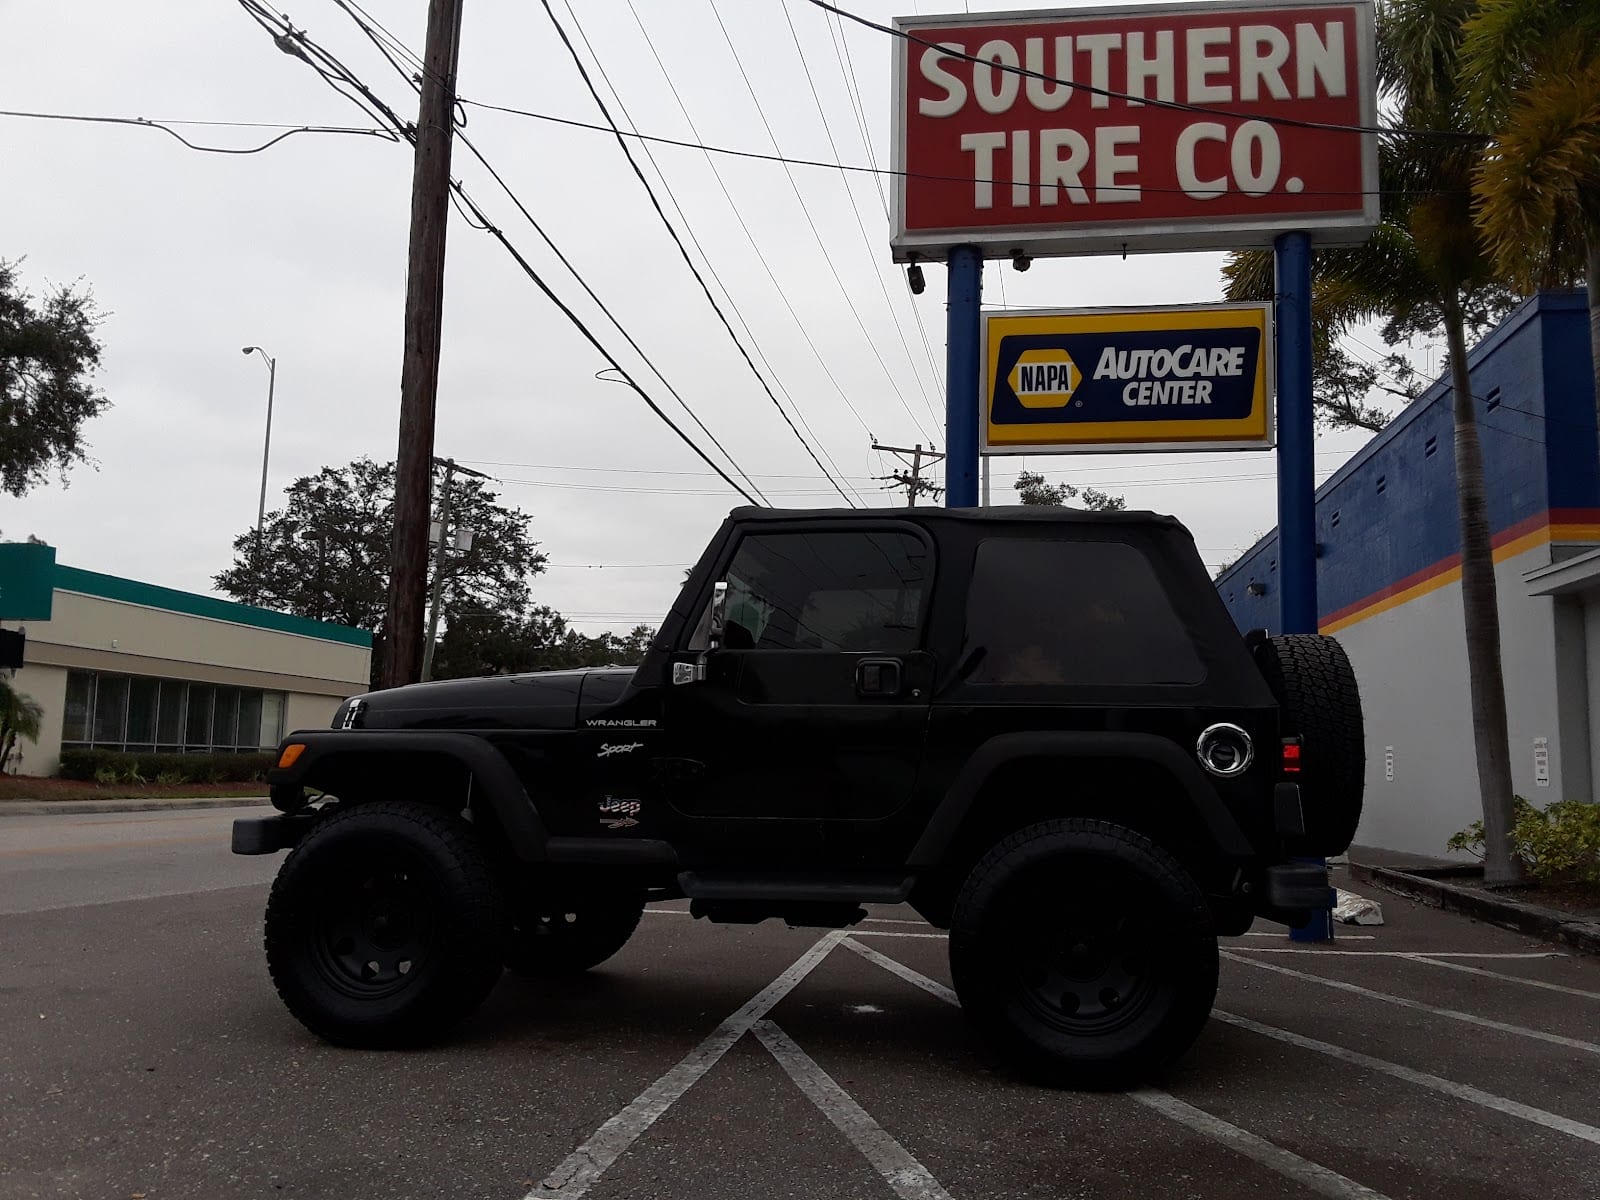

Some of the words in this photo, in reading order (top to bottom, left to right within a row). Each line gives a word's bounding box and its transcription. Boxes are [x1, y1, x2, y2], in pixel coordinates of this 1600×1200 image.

[919, 22, 1347, 118] SOUTHERN
[961, 126, 1141, 209] TIRE
[1176, 121, 1304, 199] CO.
[1021, 365, 1069, 392] NAPA
[1122, 380, 1213, 406] CENTER
[585, 719, 657, 727] WRANGLER
[597, 741, 644, 757] Sport
[597, 795, 641, 816] Jeep
